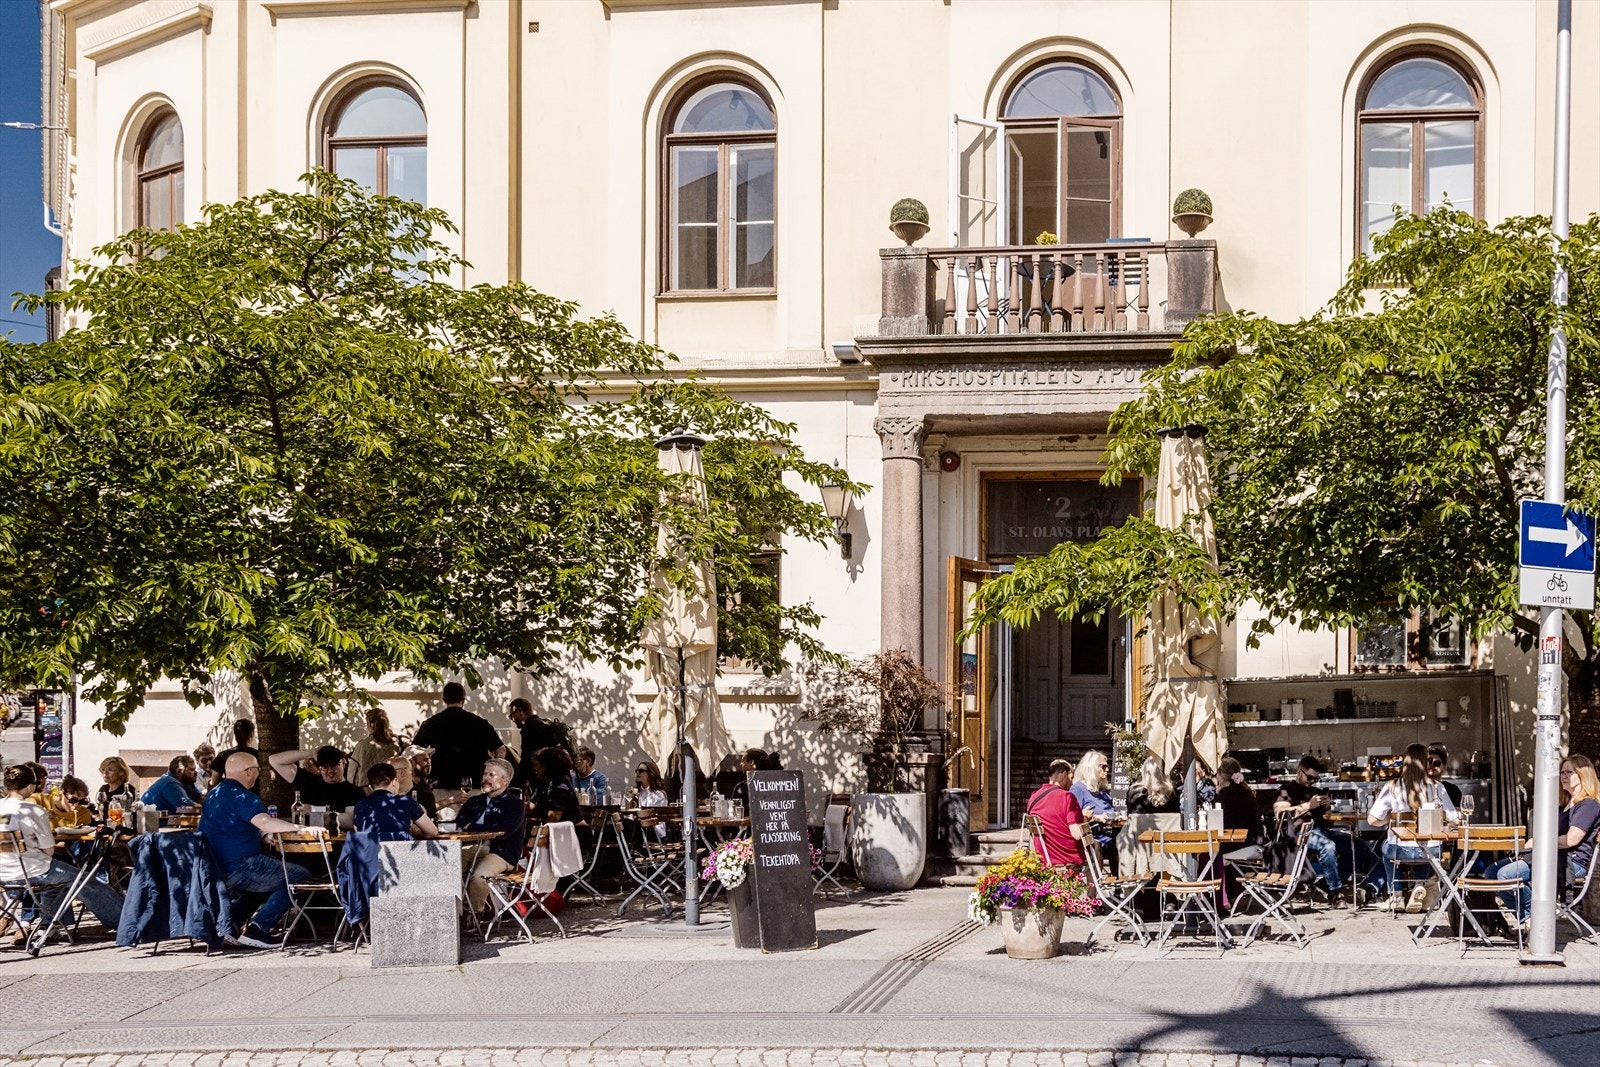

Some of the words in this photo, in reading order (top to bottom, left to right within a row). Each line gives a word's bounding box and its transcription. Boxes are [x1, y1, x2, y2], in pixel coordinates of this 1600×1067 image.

[901, 367, 1083, 387] RIKSHOSPITALETS
[1055, 497, 1071, 518] 2
[1009, 527, 1028, 538] ST.
[1033, 527, 1073, 538] OLAVS
[1542, 595, 1572, 605] unntatt
[753, 778, 799, 791] VELKOMMEN!
[759, 800, 796, 810] VENNLIGST
[769, 811, 788, 821] VENT
[765, 822, 779, 831] HER
[781, 820, 790, 831] PÅ
[760, 831, 801, 843] PLASSERING
[760, 854, 800, 867] TEKEHTOPA
